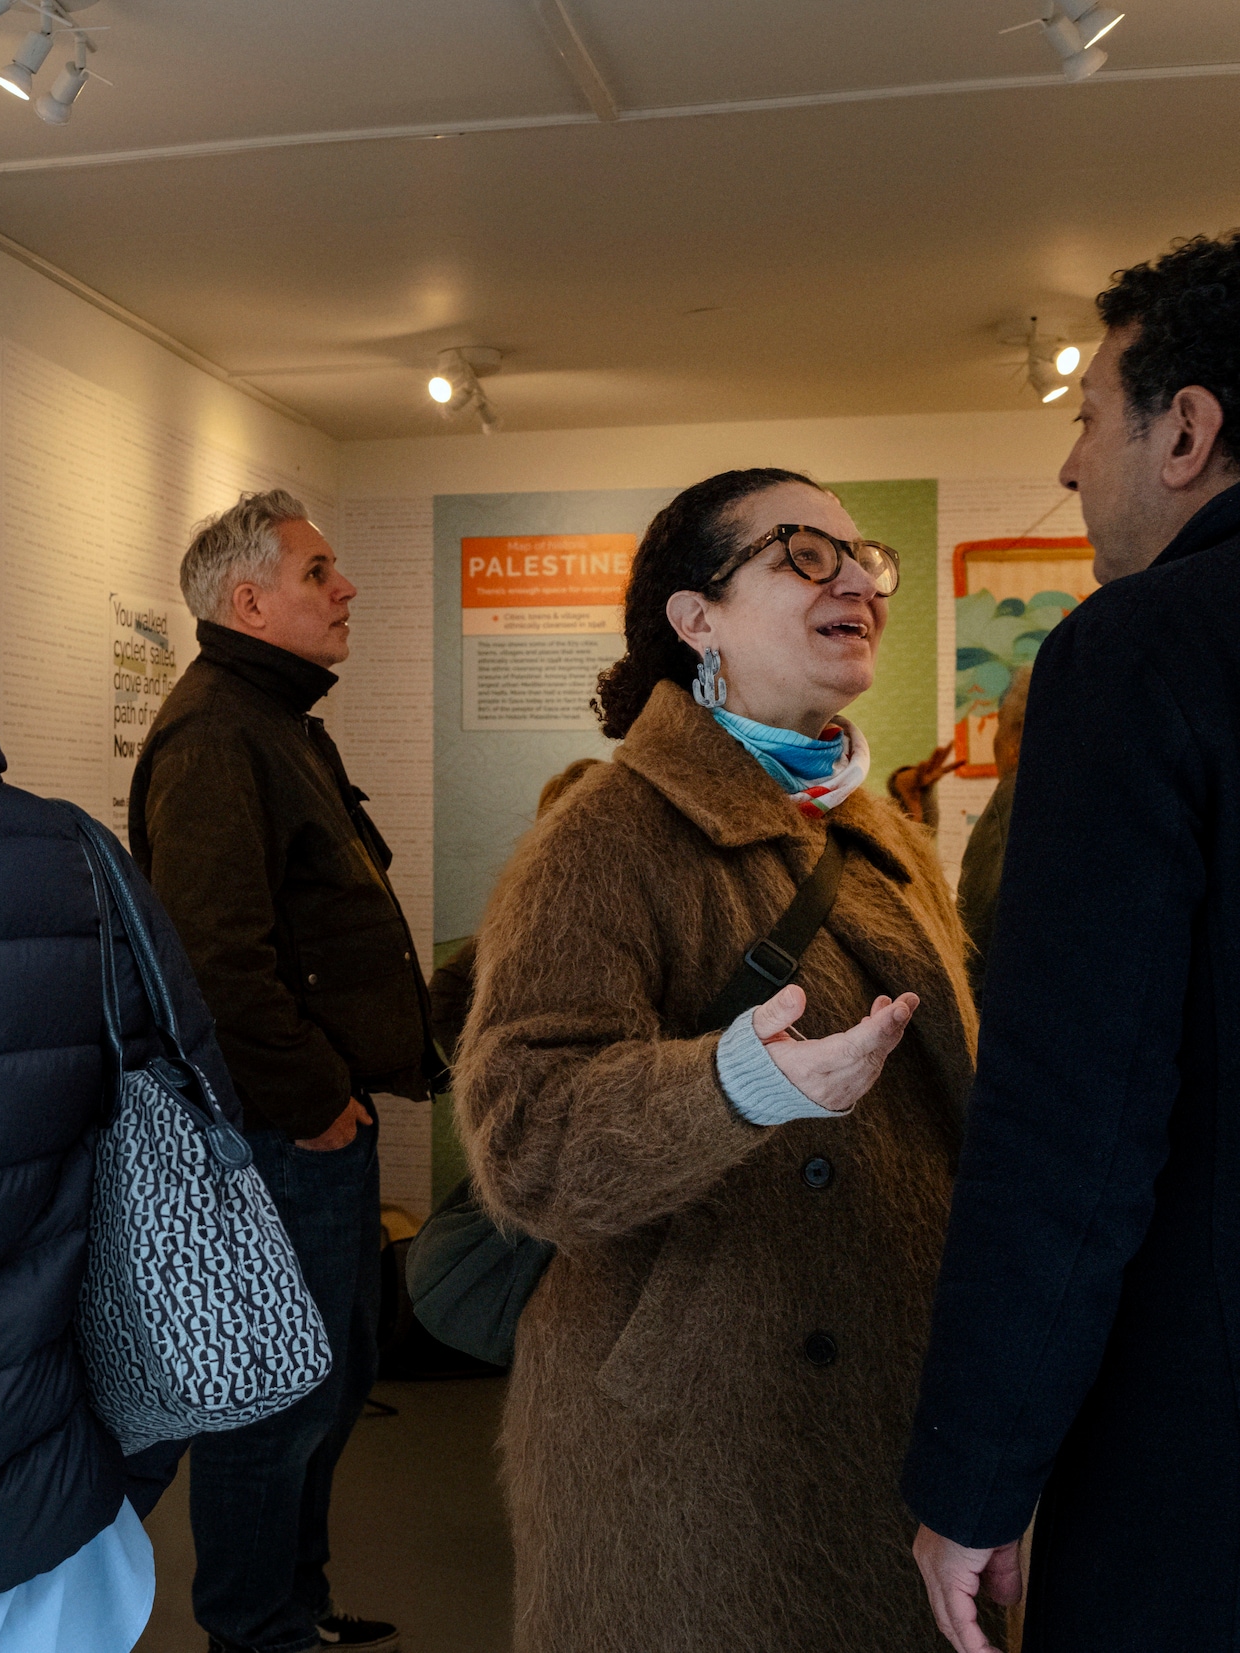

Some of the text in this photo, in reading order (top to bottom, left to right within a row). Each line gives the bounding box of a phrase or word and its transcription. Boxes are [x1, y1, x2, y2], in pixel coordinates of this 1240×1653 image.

[469, 553, 629, 577] PALESTINE
[113, 601, 133, 628] You
[113, 668, 142, 694] drove
[143, 672, 161, 697] and
[114, 701, 136, 729] path
[138, 702, 148, 726] of
[113, 733, 137, 759] Now
